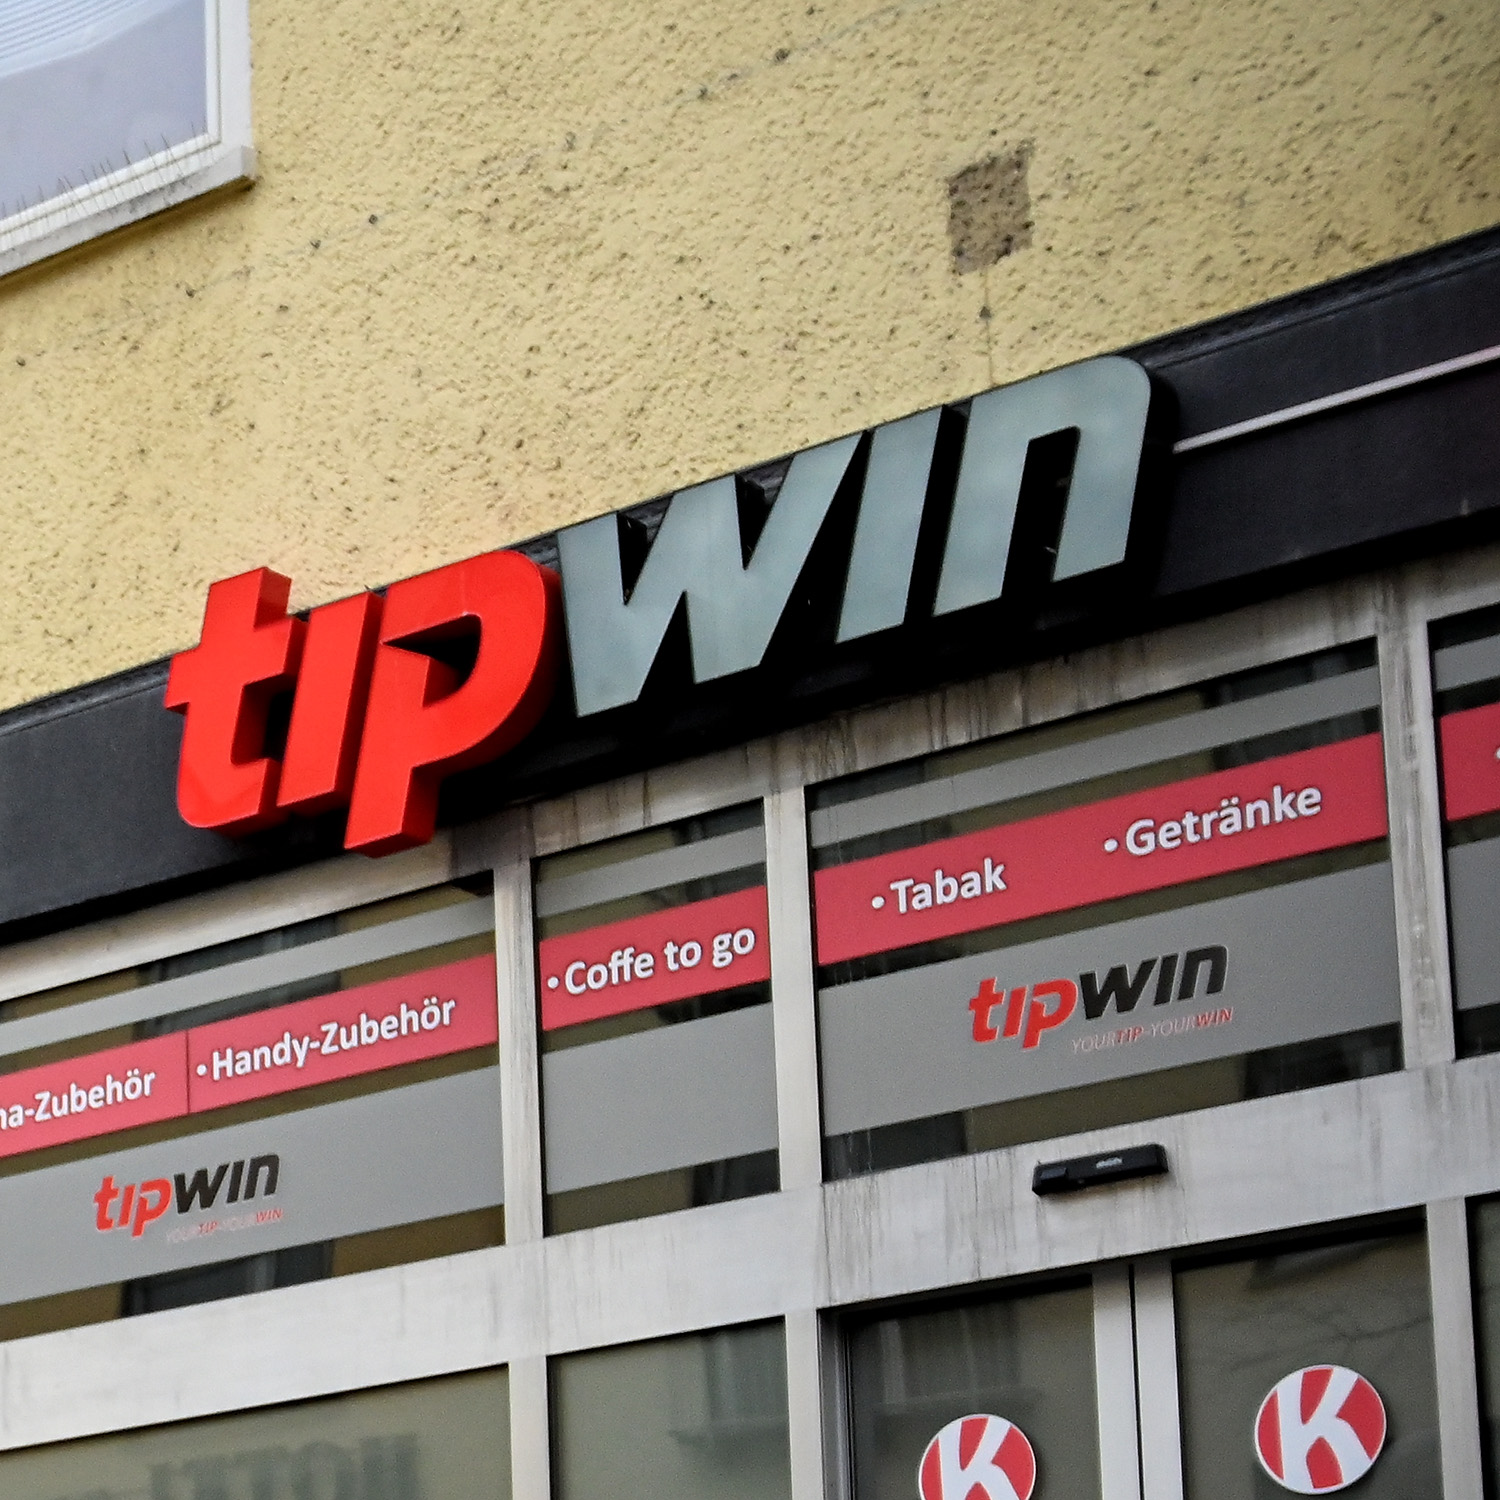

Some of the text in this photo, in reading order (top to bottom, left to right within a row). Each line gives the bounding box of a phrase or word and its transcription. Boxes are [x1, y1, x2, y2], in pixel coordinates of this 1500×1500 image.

[164, 354, 1158, 858] tipwin
[890, 782, 1323, 914] Tabak Getränke
[564, 927, 756, 995] Coffe to go
[968, 943, 1228, 1050] tipwin
[210, 995, 457, 1083] Handy-Zubehör
[93, 1151, 281, 1238] tipwin
